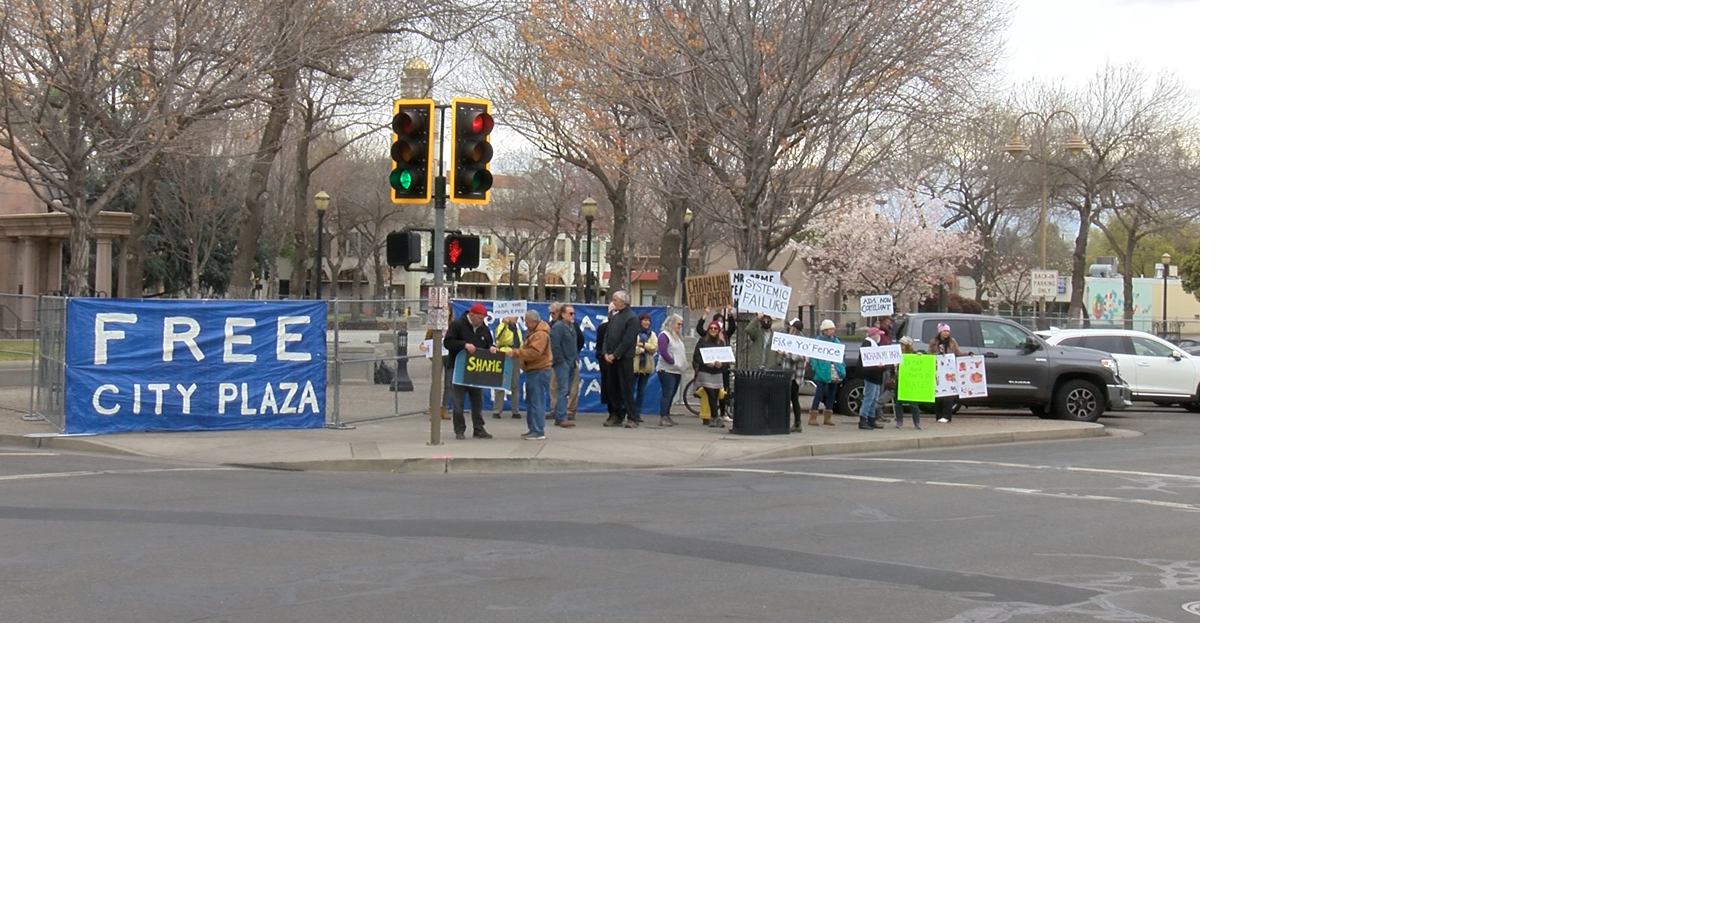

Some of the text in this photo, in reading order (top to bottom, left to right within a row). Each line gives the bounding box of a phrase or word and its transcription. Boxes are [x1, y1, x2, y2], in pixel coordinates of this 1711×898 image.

[745, 278, 789, 300] SYSTEMIC
[689, 290, 731, 311] CHICANERY
[742, 291, 787, 315] FAILURE
[94, 312, 312, 365] FREE
[811, 343, 841, 357] Fence
[466, 356, 502, 373] SHAME
[92, 380, 320, 416] CITY PLAZA
